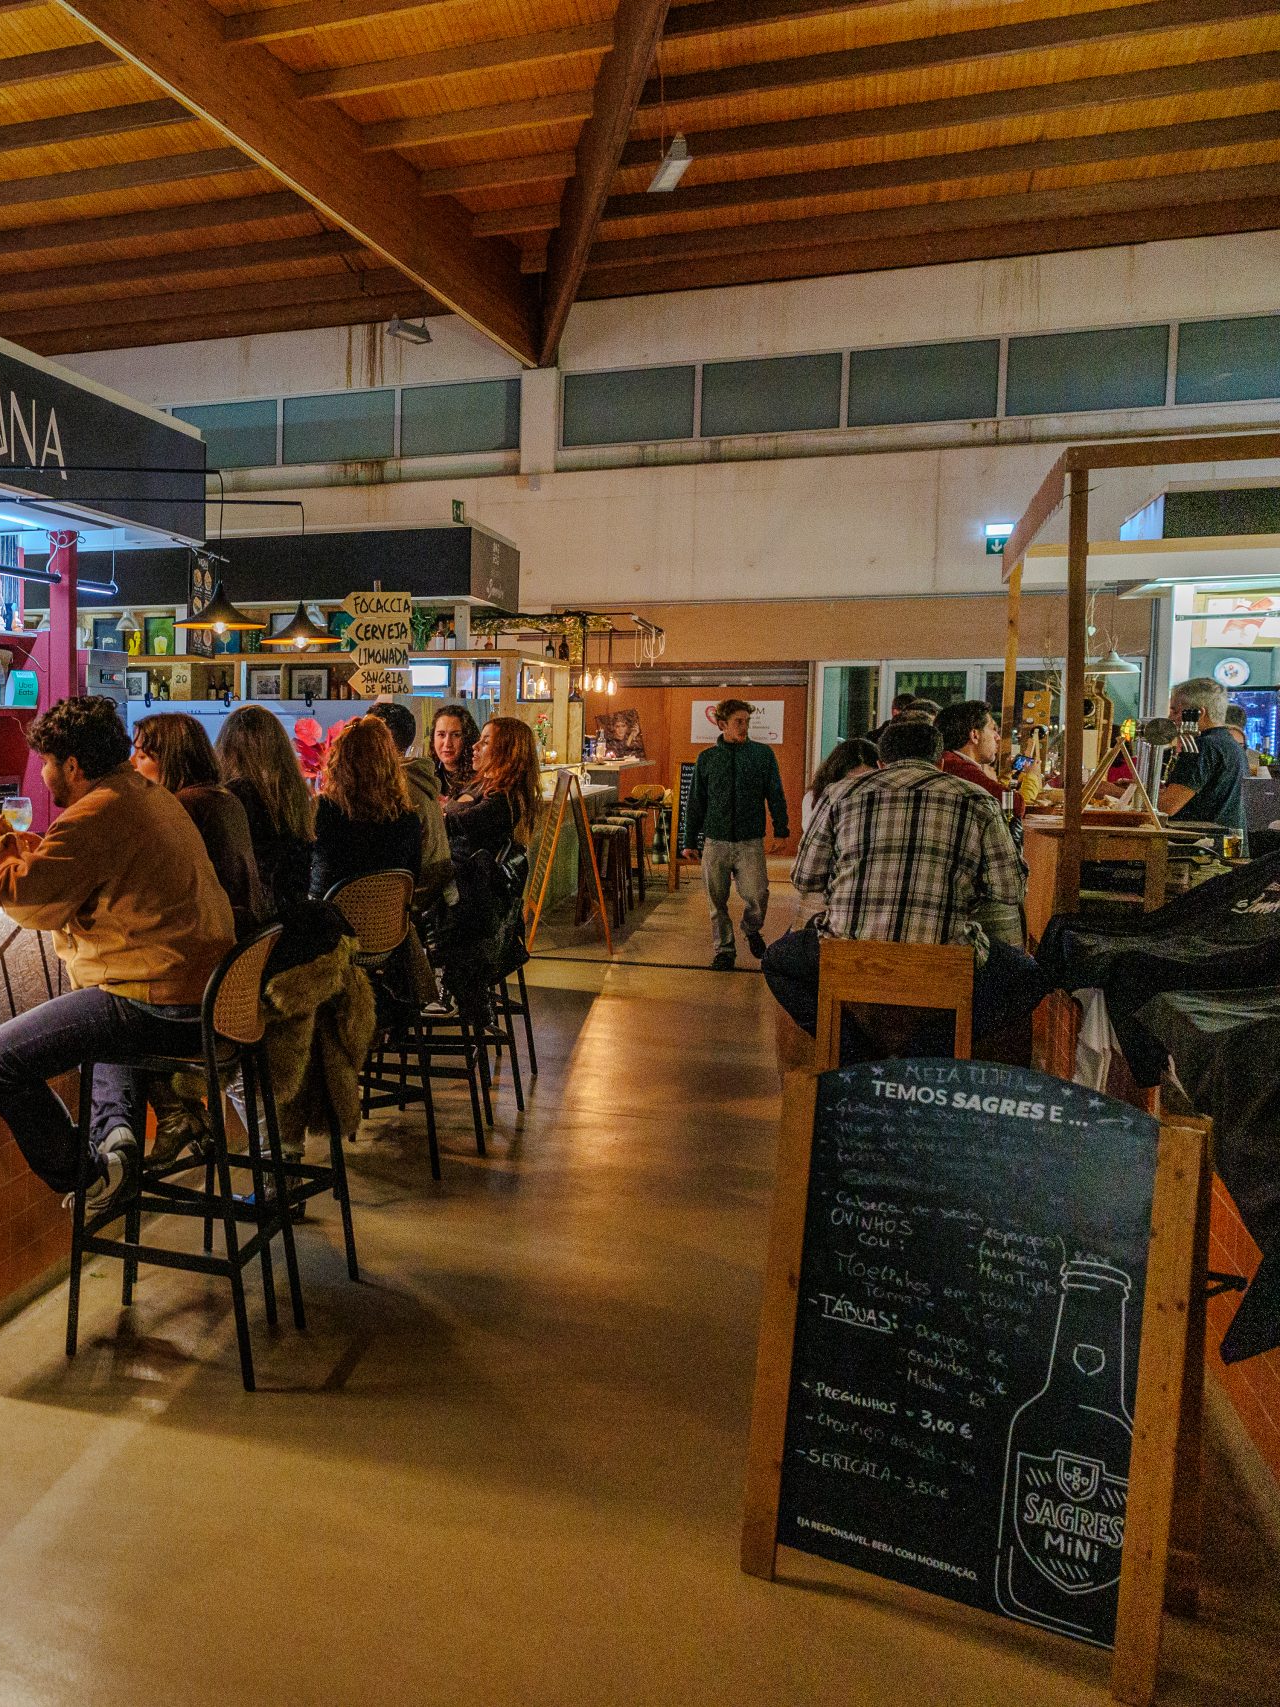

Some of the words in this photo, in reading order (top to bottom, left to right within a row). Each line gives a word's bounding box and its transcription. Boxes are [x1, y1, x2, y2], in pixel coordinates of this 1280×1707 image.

[354, 596, 411, 614] FOCACCIA
[355, 623, 408, 641] CERVEJA
[359, 648, 409, 666] LIMONADA
[176, 674, 188, 684] 20
[361, 672, 404, 684] SANGRIA
[18, 689, 34, 697] Eats
[365, 684, 376, 693] DE
[872, 1080, 948, 1106] TEMOS
[951, 1092, 1046, 1120] SAGRES
[1049, 1105, 1064, 1123] E
[831, 1208, 913, 1235] OVINHOS
[1023, 1492, 1124, 1549] SAGRES
[895, 1547, 917, 1562] COM
